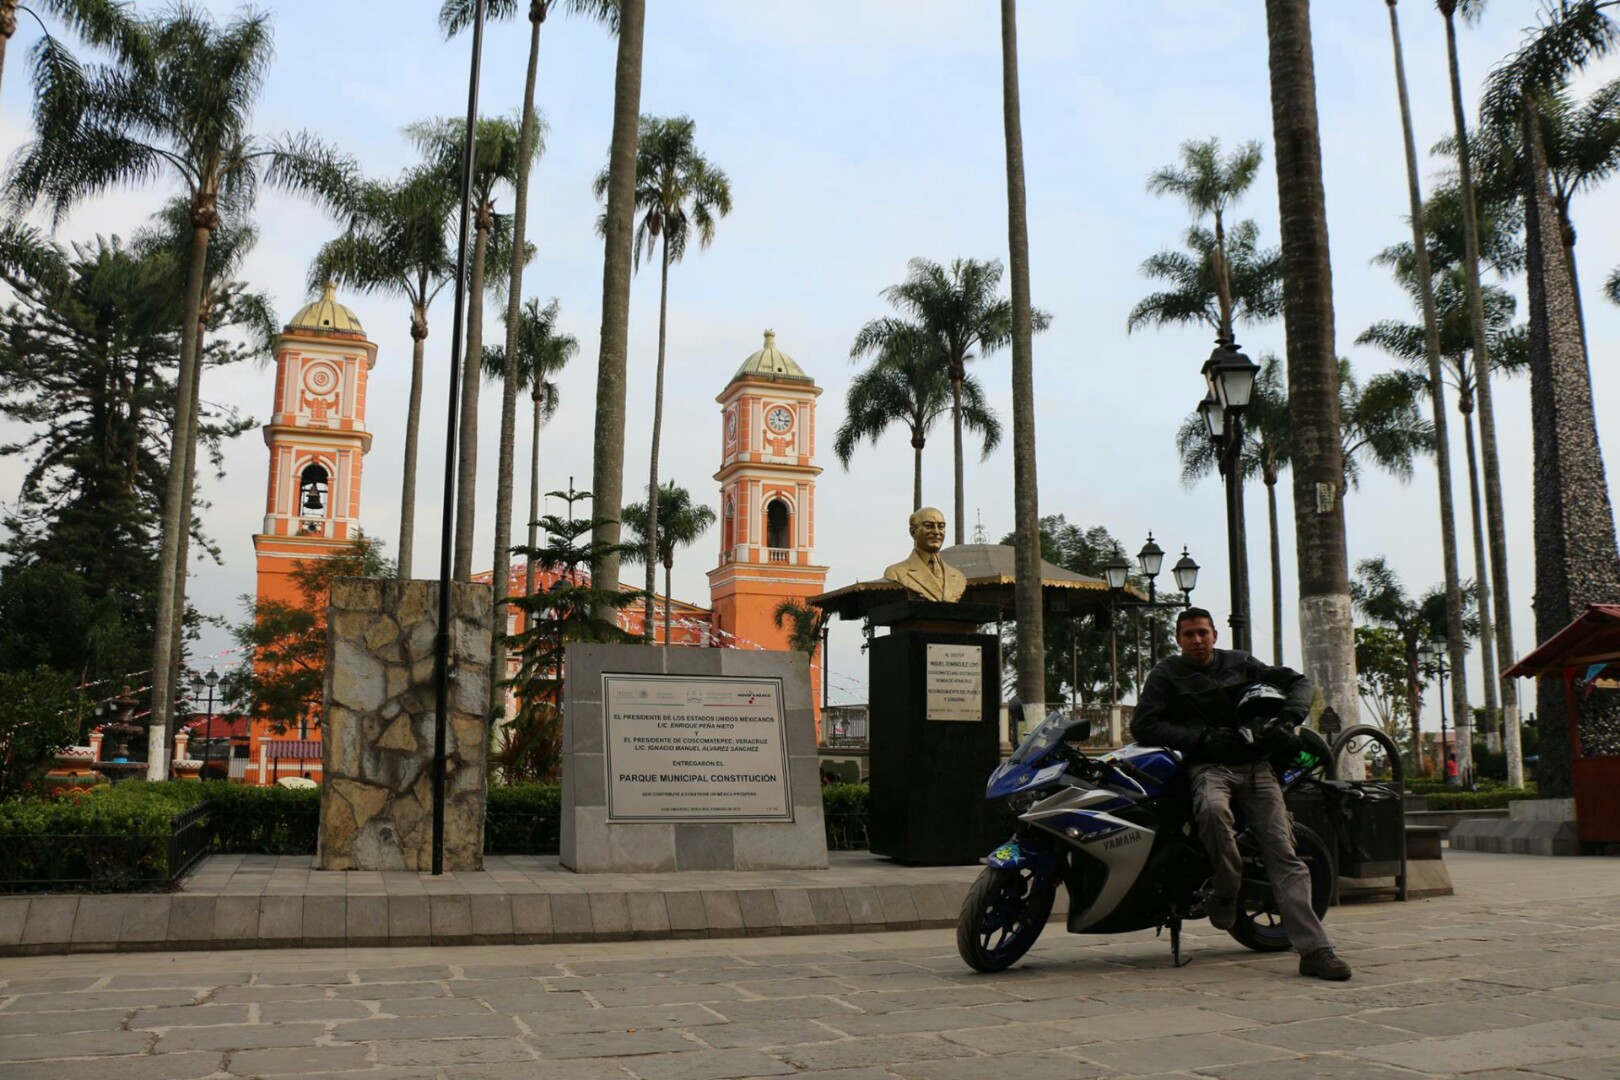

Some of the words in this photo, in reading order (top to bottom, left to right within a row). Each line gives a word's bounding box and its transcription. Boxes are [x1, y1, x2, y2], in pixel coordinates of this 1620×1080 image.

[620, 774, 657, 782] PARQUE
[660, 774, 708, 782] MUNICIPAL
[711, 773, 776, 782] CONSTITUCIÓN
[1103, 830, 1142, 851] YAMAHA
